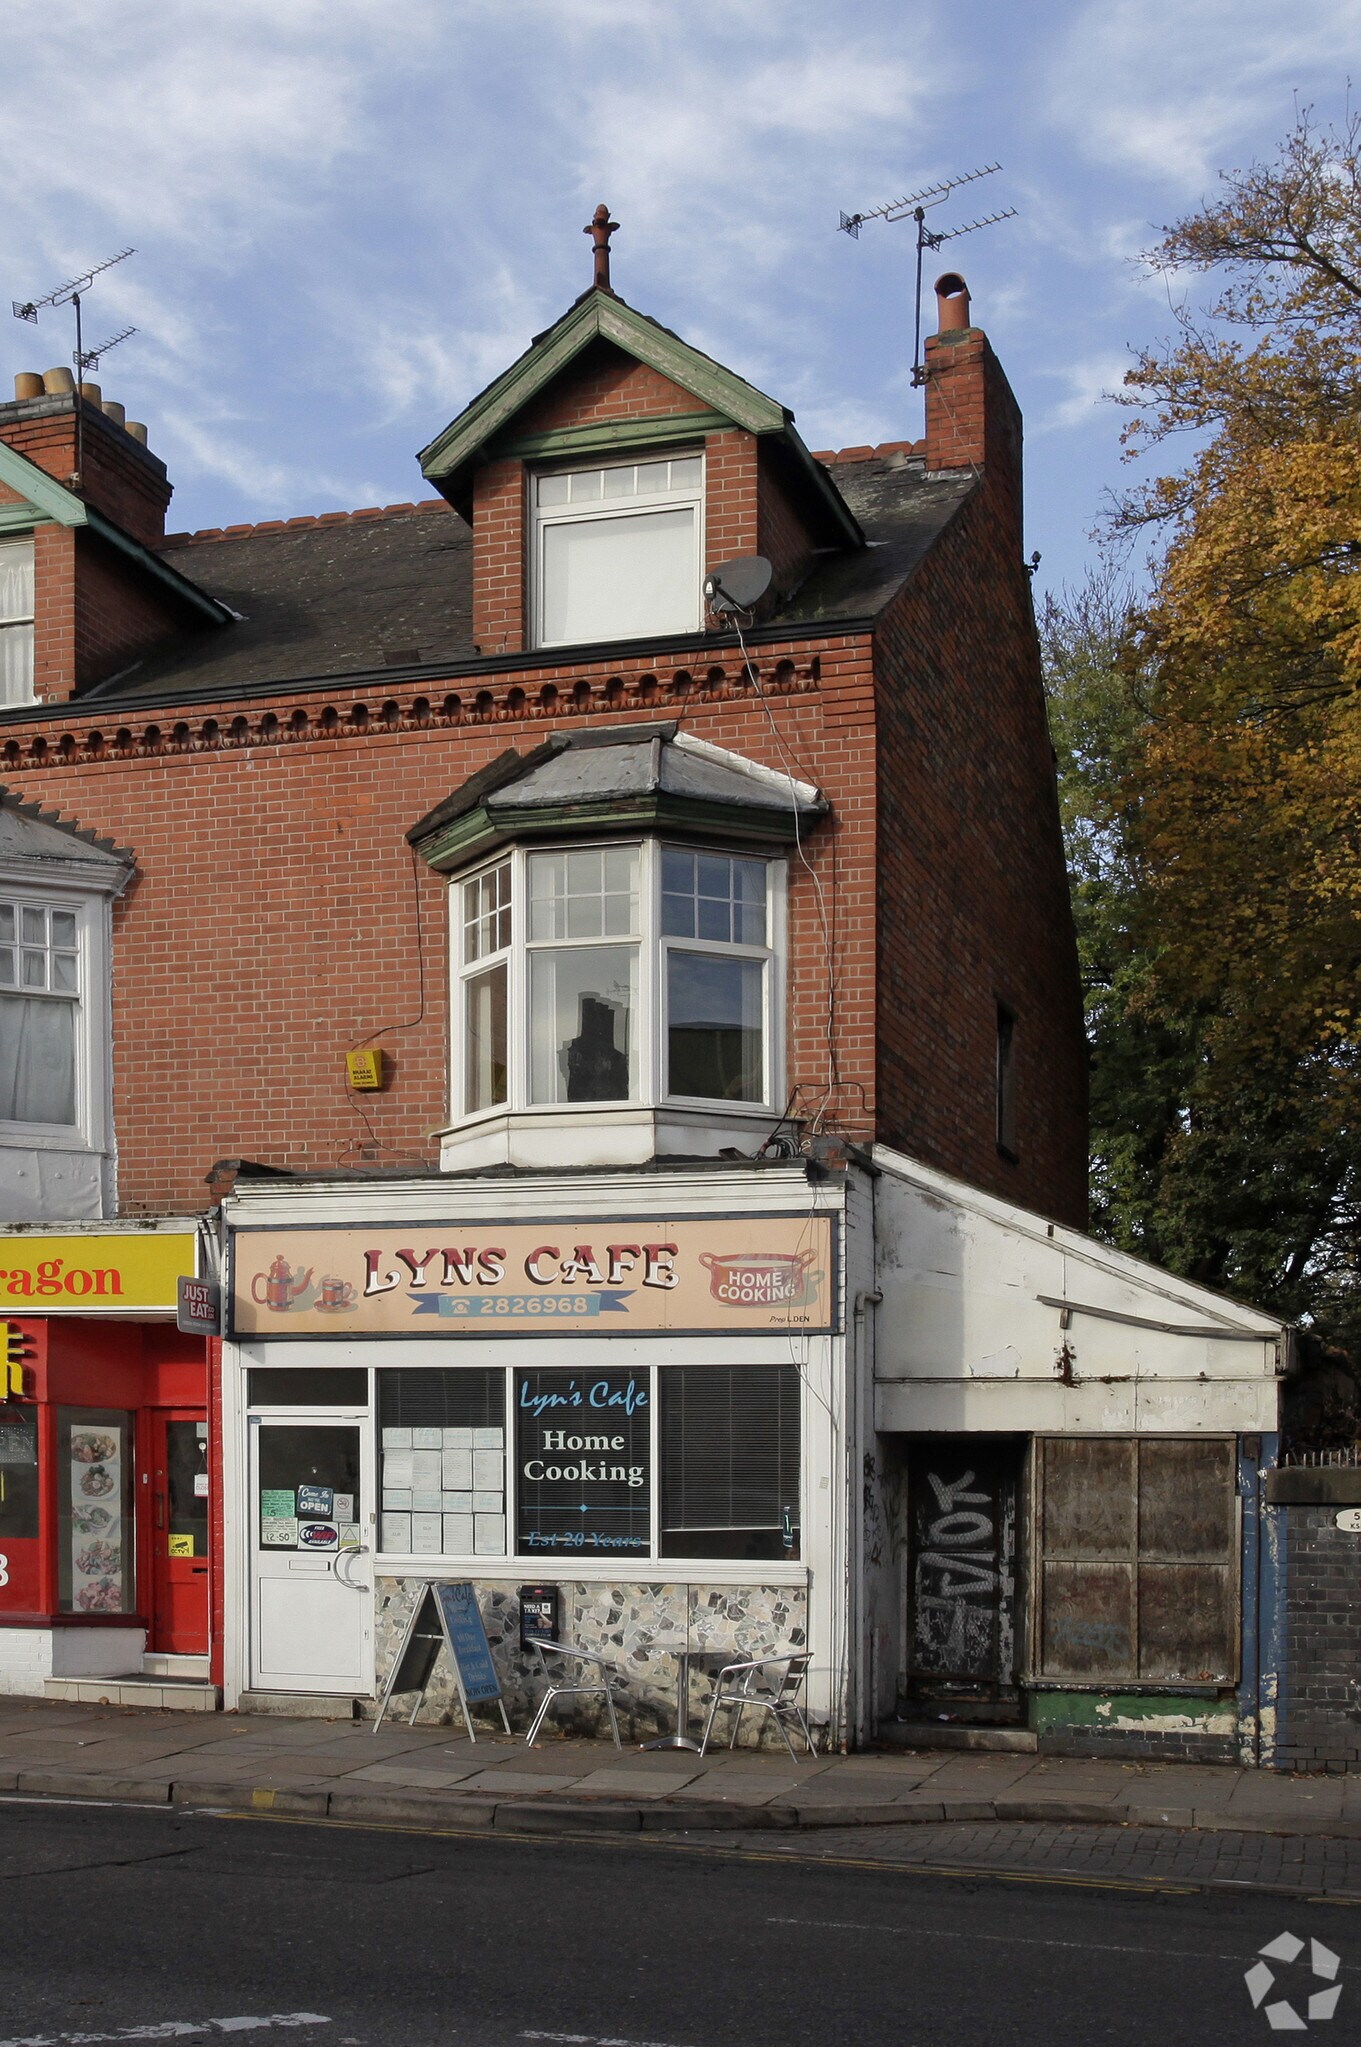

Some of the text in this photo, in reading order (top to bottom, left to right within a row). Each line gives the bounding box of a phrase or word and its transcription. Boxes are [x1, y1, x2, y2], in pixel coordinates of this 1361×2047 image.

[363, 1243, 681, 1297] LYNS CAFE
[729, 1271, 782, 1287] HOME
[183, 1284, 209, 1302] JUST
[718, 1284, 796, 1301] COOKING
[190, 1301, 209, 1318] EAT
[480, 1297, 588, 1314] 2826968
[520, 1380, 648, 1417] Lyn's Cafe
[543, 1430, 625, 1450] Home
[523, 1460, 645, 1487] Cooking
[300, 1501, 329, 1512] OPEN
[528, 1532, 642, 1547] Est 20 Years
[481, 1684, 498, 1695] OPEN
